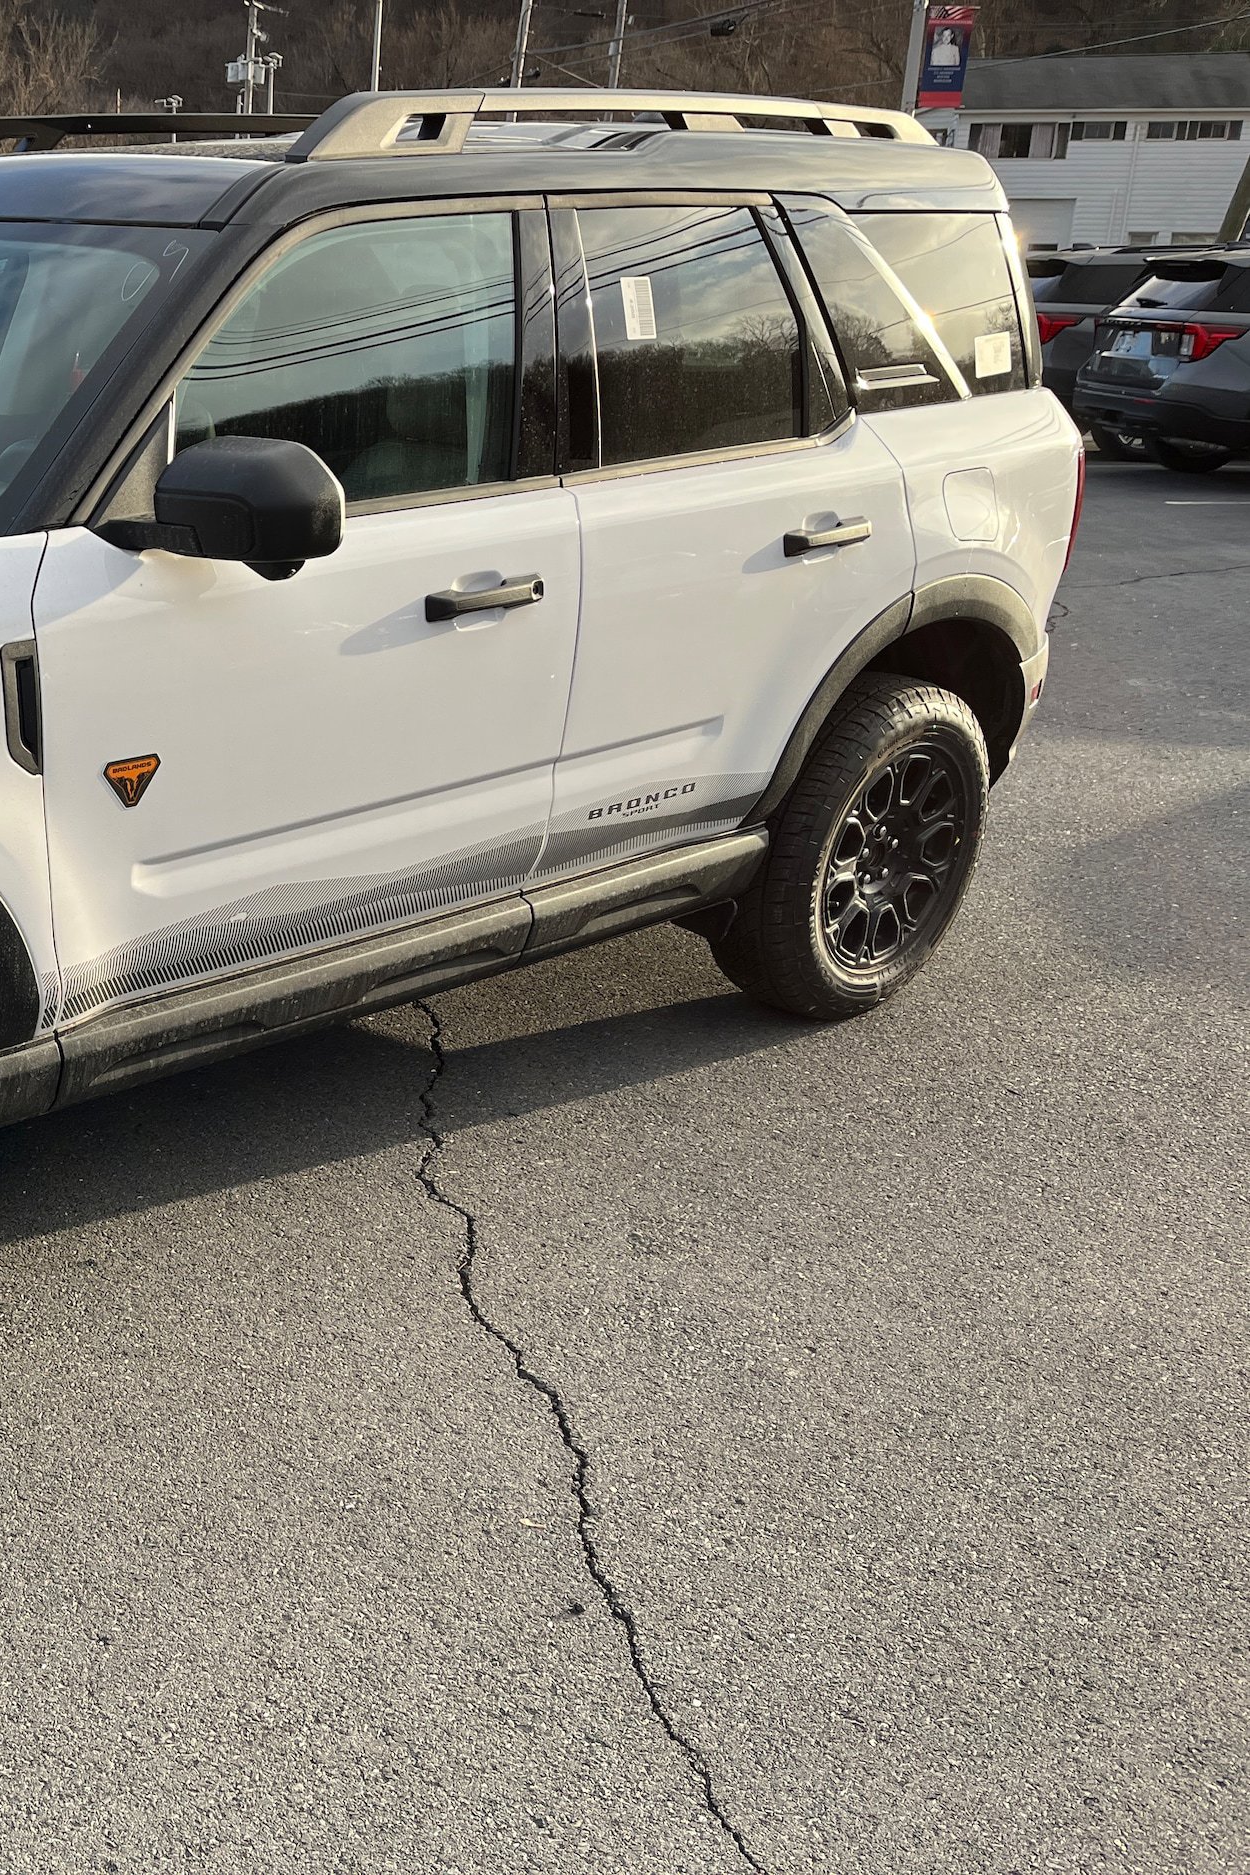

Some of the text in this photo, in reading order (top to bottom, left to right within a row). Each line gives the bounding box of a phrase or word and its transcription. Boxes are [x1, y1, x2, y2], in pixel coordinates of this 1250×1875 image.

[111, 760, 152, 774] BADLANDS
[587, 782, 696, 820] BRONCO
[621, 803, 662, 819] SPORT
